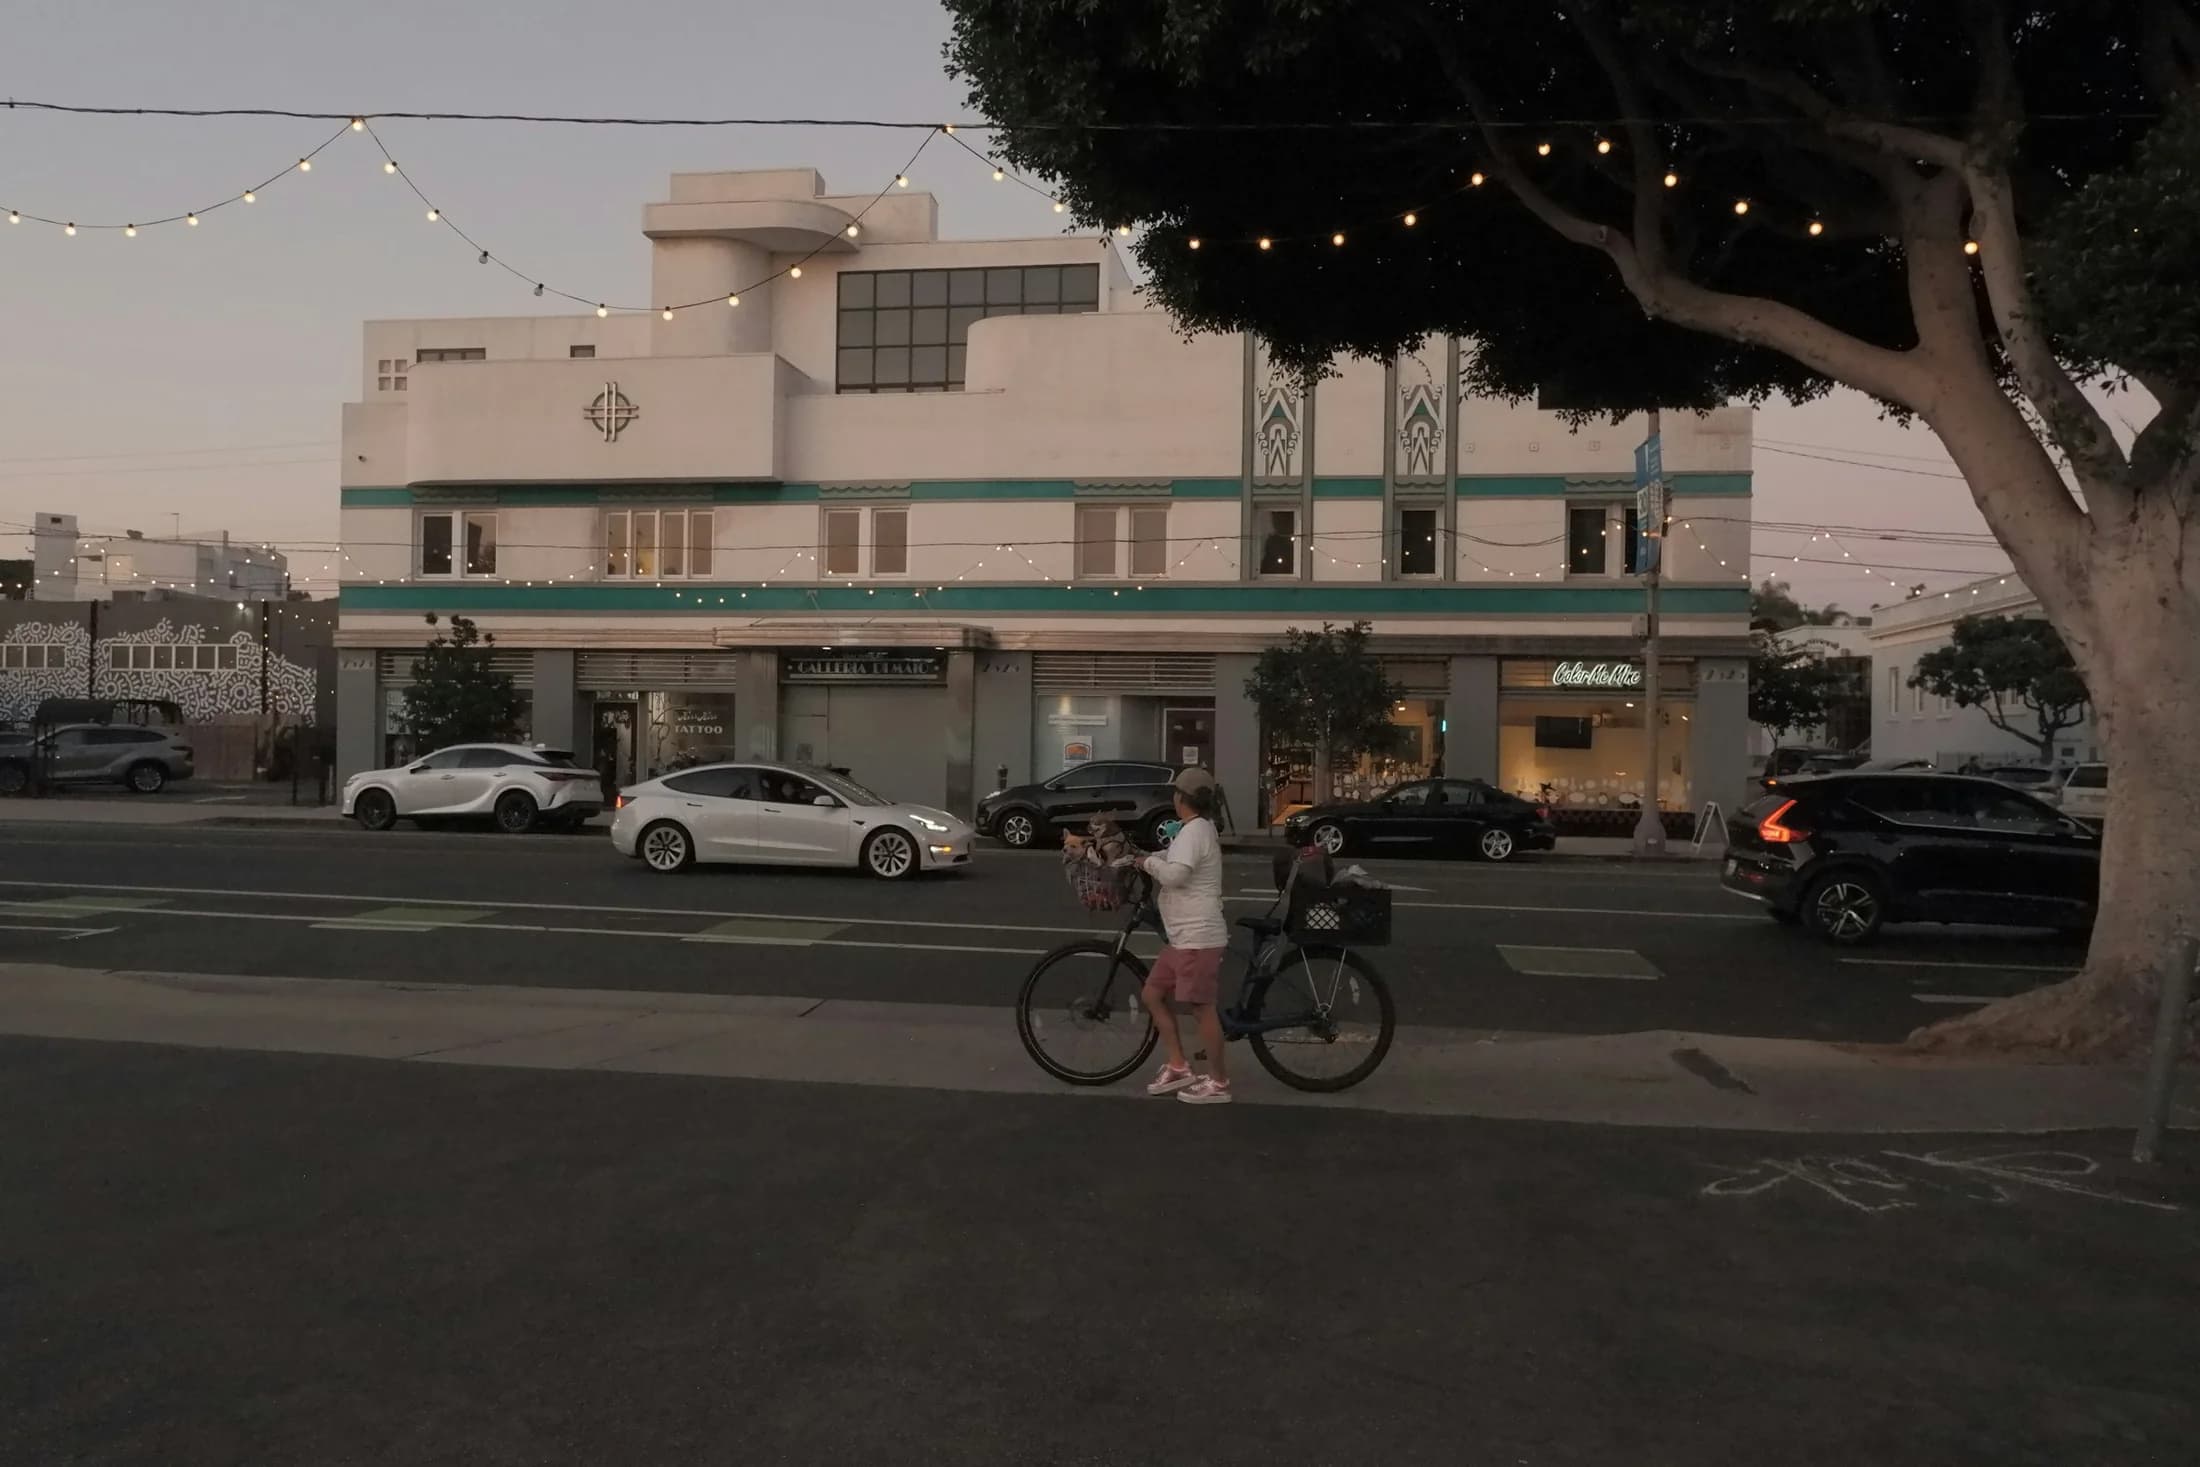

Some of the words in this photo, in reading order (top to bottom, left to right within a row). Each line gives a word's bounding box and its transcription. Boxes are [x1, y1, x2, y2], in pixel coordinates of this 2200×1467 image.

[1553, 661, 1590, 686] Color
[1587, 663, 1609, 686] Me
[674, 725, 723, 734] TATTOO
